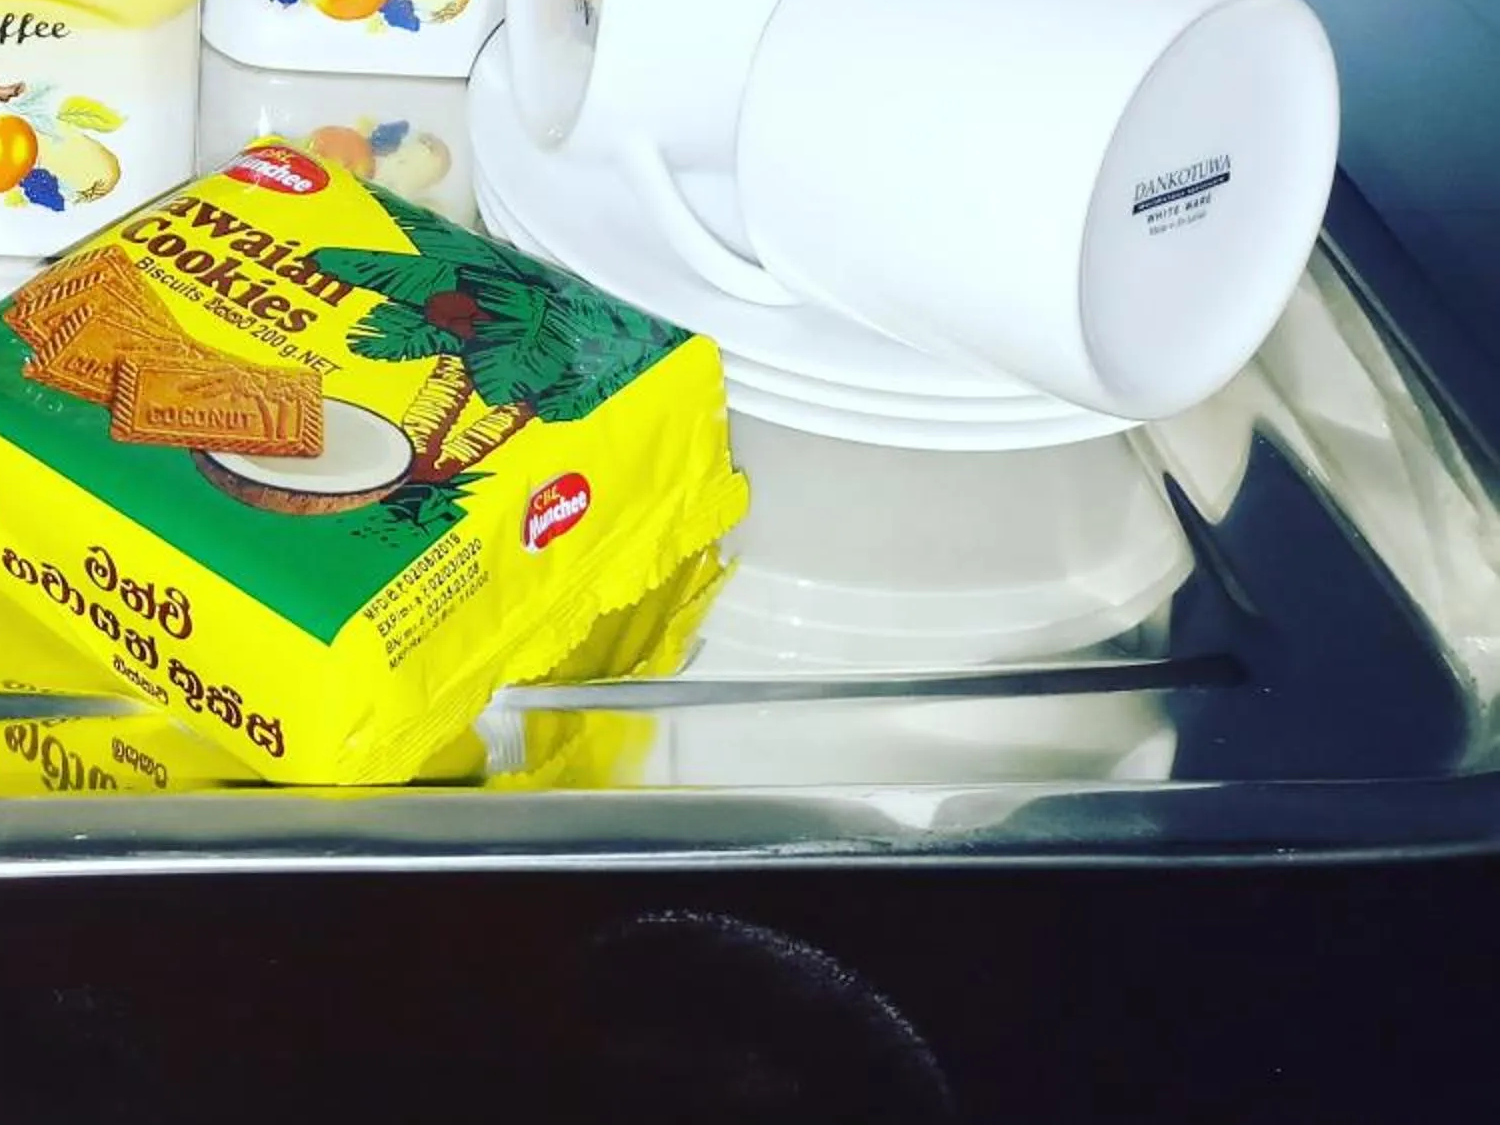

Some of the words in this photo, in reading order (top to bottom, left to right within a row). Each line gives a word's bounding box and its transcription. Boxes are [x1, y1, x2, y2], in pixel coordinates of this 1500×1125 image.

[1133, 153, 1232, 202] DANKOTUWA
[1146, 204, 1180, 224] WHITE
[1184, 193, 1213, 212] WARE
[121, 216, 319, 333] Cookies
[135, 256, 204, 303] Biscuits
[251, 324, 287, 348] 200
[146, 404, 256, 428] COCONUT
[528, 490, 587, 542] Munchee
